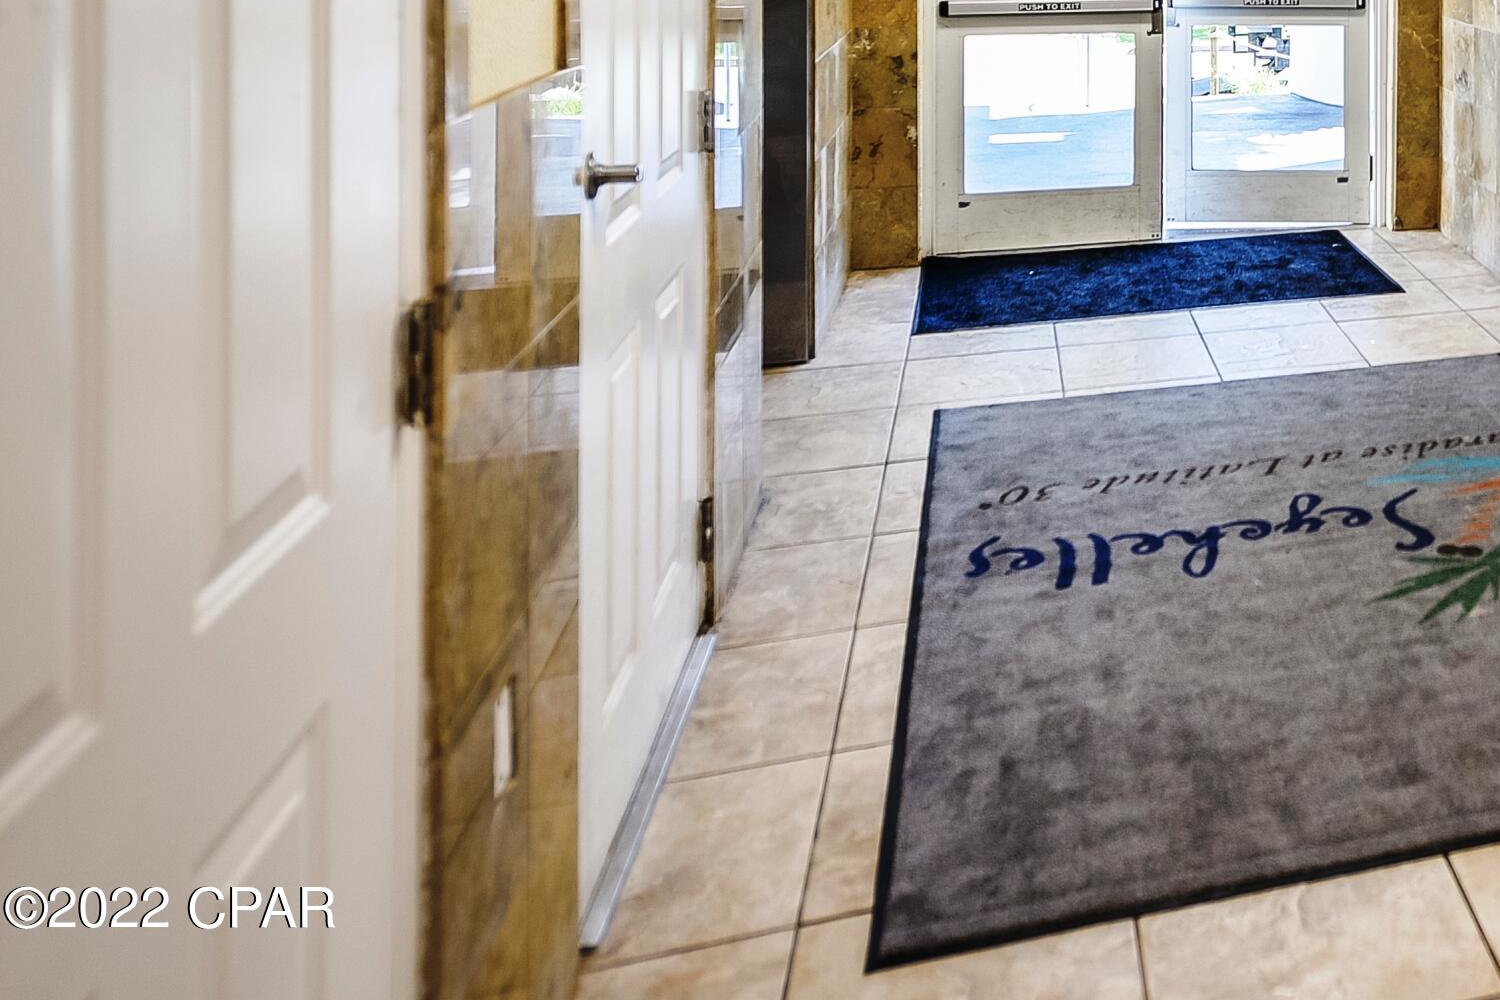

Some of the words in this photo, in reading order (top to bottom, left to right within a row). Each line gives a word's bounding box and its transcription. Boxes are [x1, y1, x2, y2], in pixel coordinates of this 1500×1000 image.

[1060, 2, 1080, 10] EXIT
[1302, 450, 1343, 469] at
[1082, 455, 1287, 494] Latitude
[965, 488, 1436, 590] Seychelles
